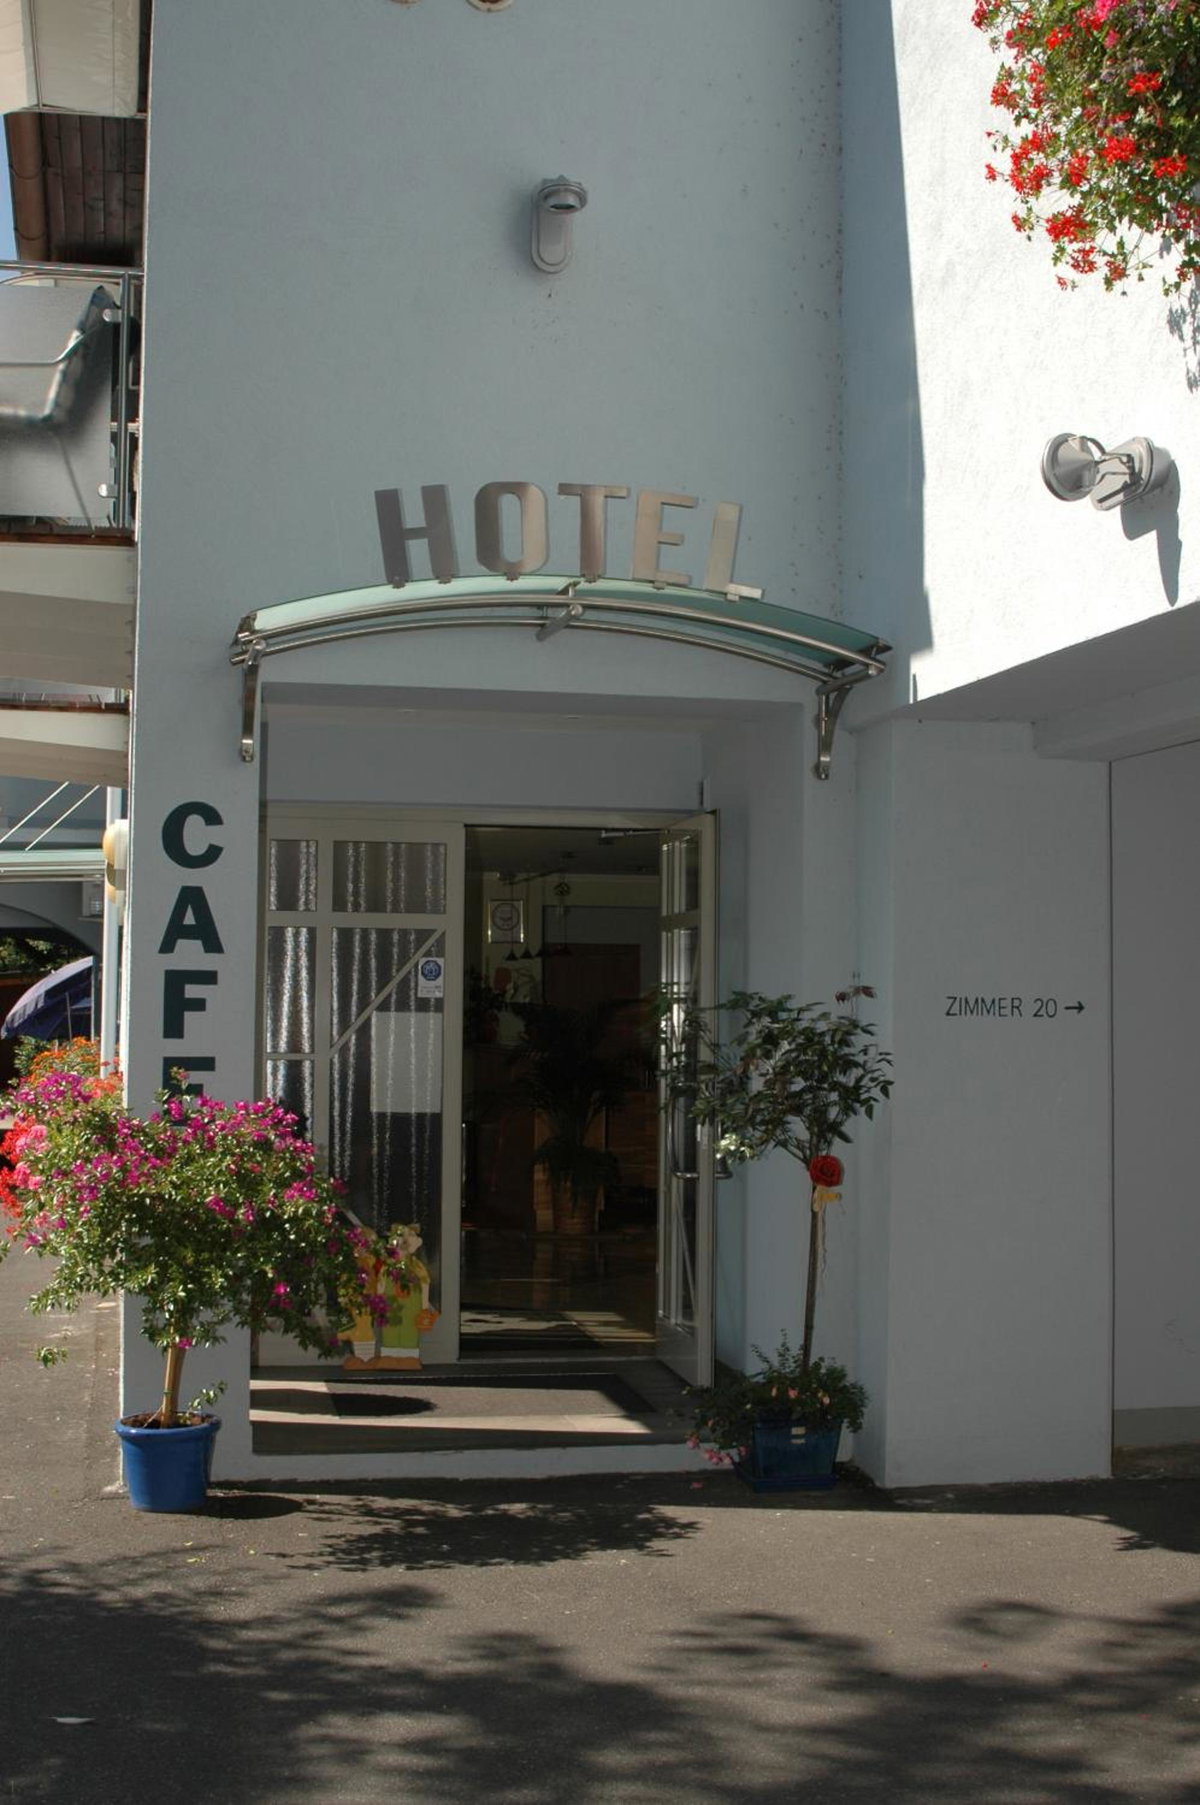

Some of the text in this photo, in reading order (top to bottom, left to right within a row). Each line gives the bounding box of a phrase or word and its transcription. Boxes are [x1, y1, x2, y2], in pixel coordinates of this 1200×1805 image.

[374, 481, 763, 600] HOTEL
[945, 996, 1058, 1018] ZIMMER 20
